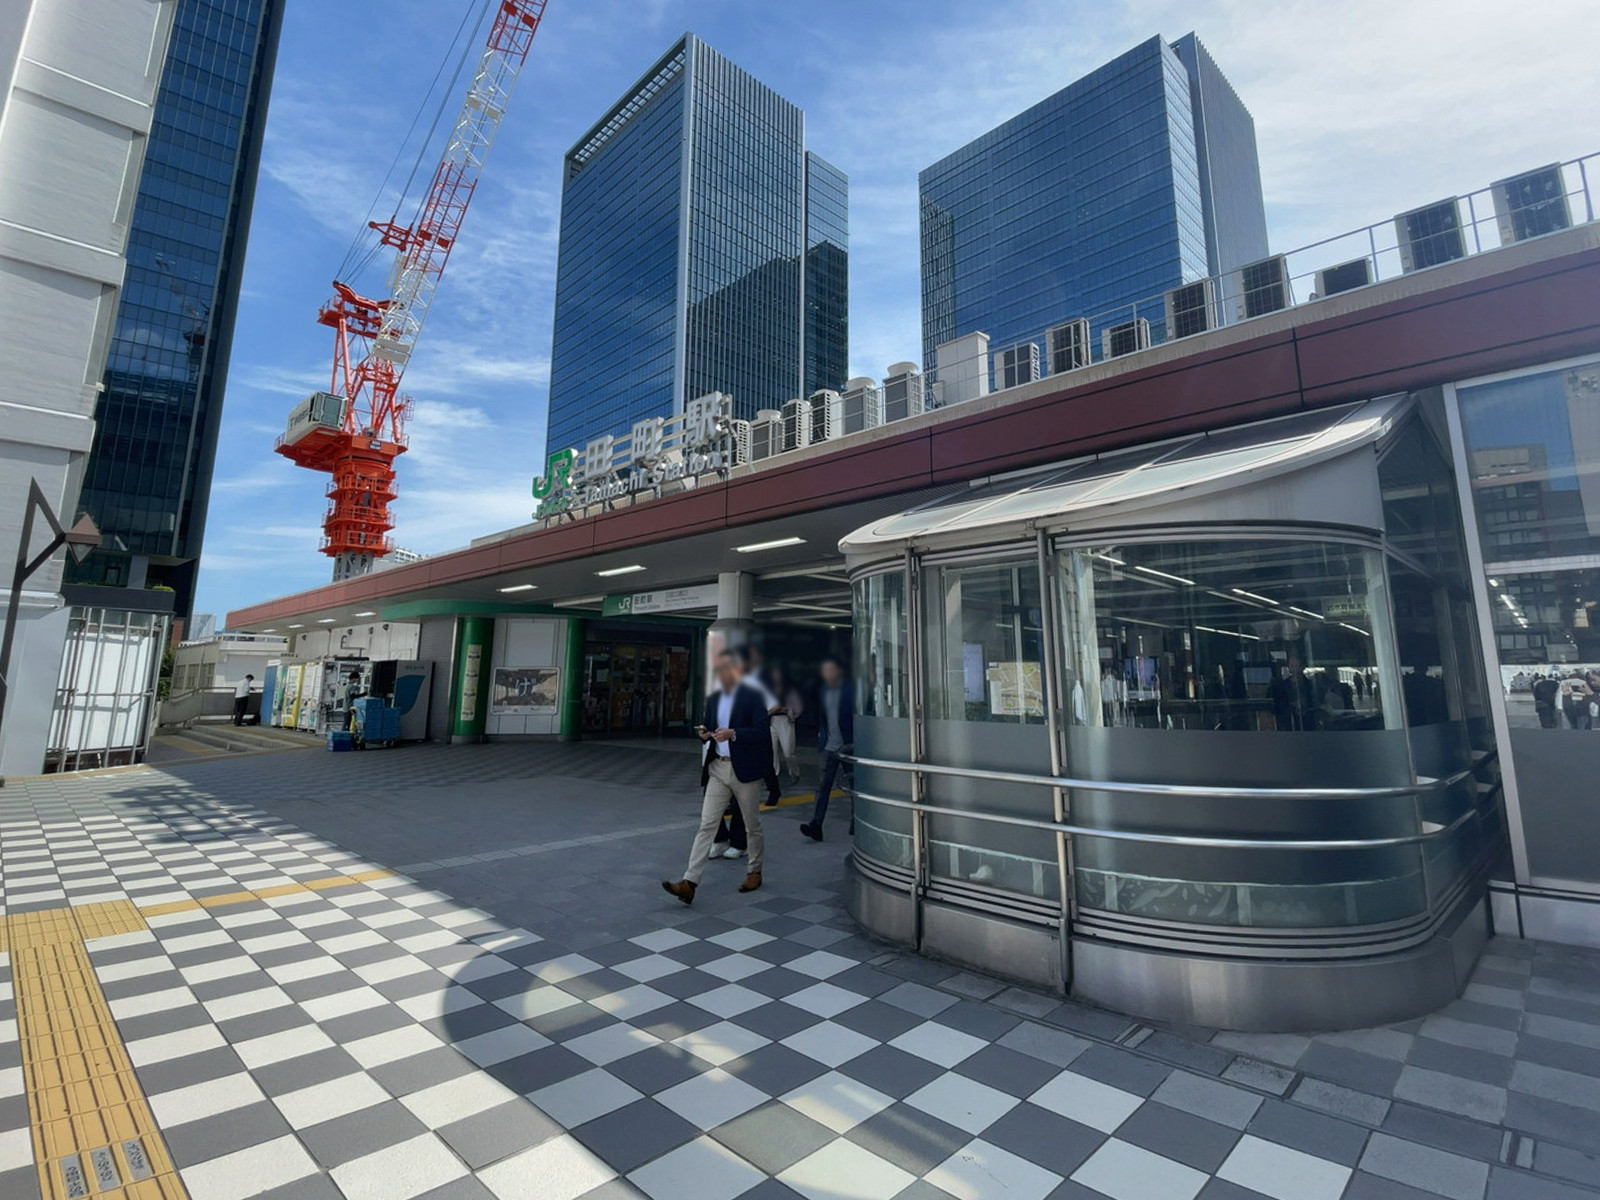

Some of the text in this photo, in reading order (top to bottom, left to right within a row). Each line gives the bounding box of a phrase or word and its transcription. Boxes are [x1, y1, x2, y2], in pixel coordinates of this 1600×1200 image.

[586, 391, 723, 480] 田町駅
[532, 448, 573, 499] JR
[652, 450, 723, 484] Station
[618, 597, 631, 610] JR
